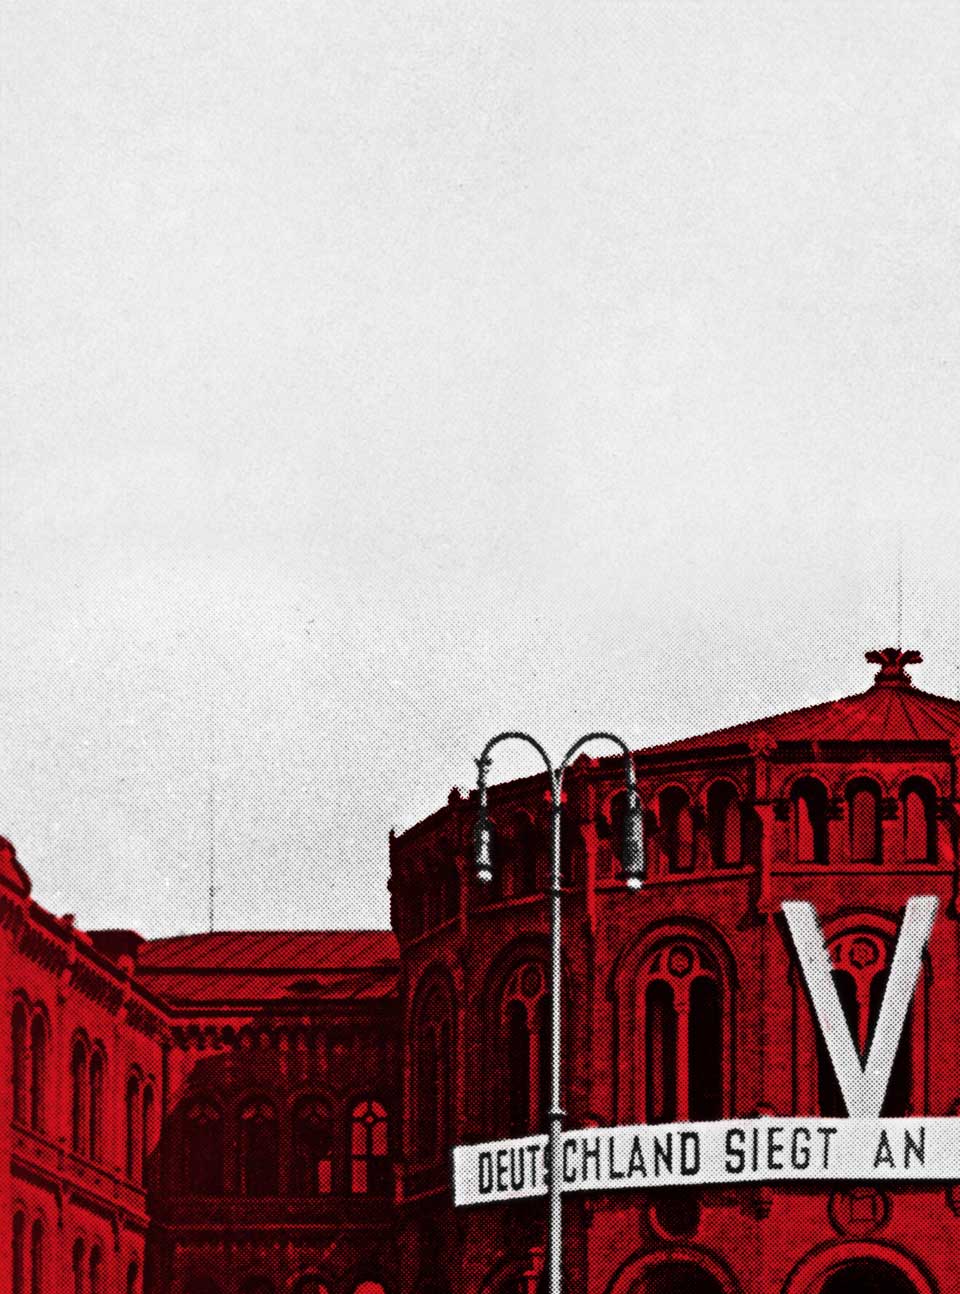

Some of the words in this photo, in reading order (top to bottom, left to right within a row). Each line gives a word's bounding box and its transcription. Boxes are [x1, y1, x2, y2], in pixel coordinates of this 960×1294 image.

[780, 895, 940, 1118] V
[724, 1126, 838, 1174] SIEGT
[873, 1126, 926, 1171] AN
